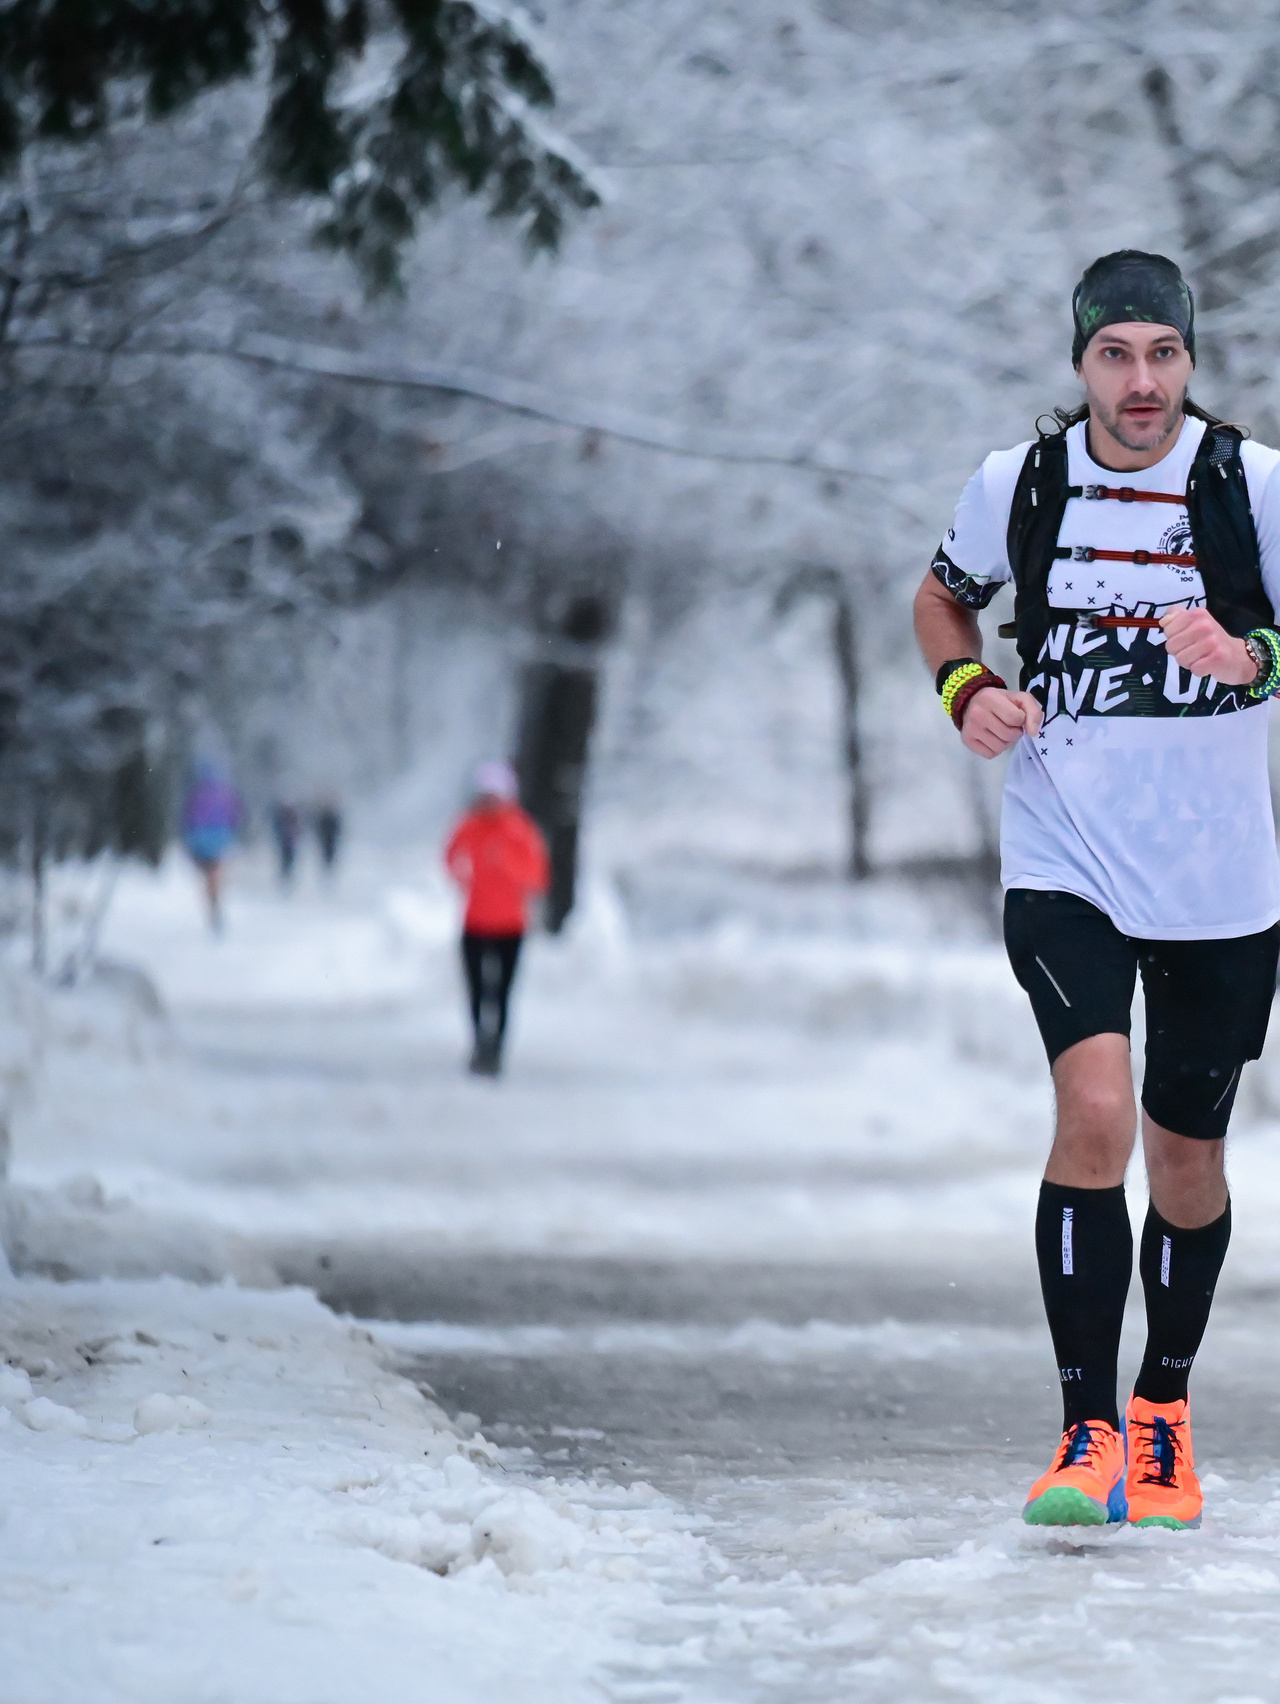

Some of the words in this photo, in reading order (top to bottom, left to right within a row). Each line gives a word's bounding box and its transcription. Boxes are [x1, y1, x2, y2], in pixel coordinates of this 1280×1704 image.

[1164, 563, 1187, 575] LTRA
[1037, 598, 1206, 664] NEVE
[1162, 654, 1218, 704] U
